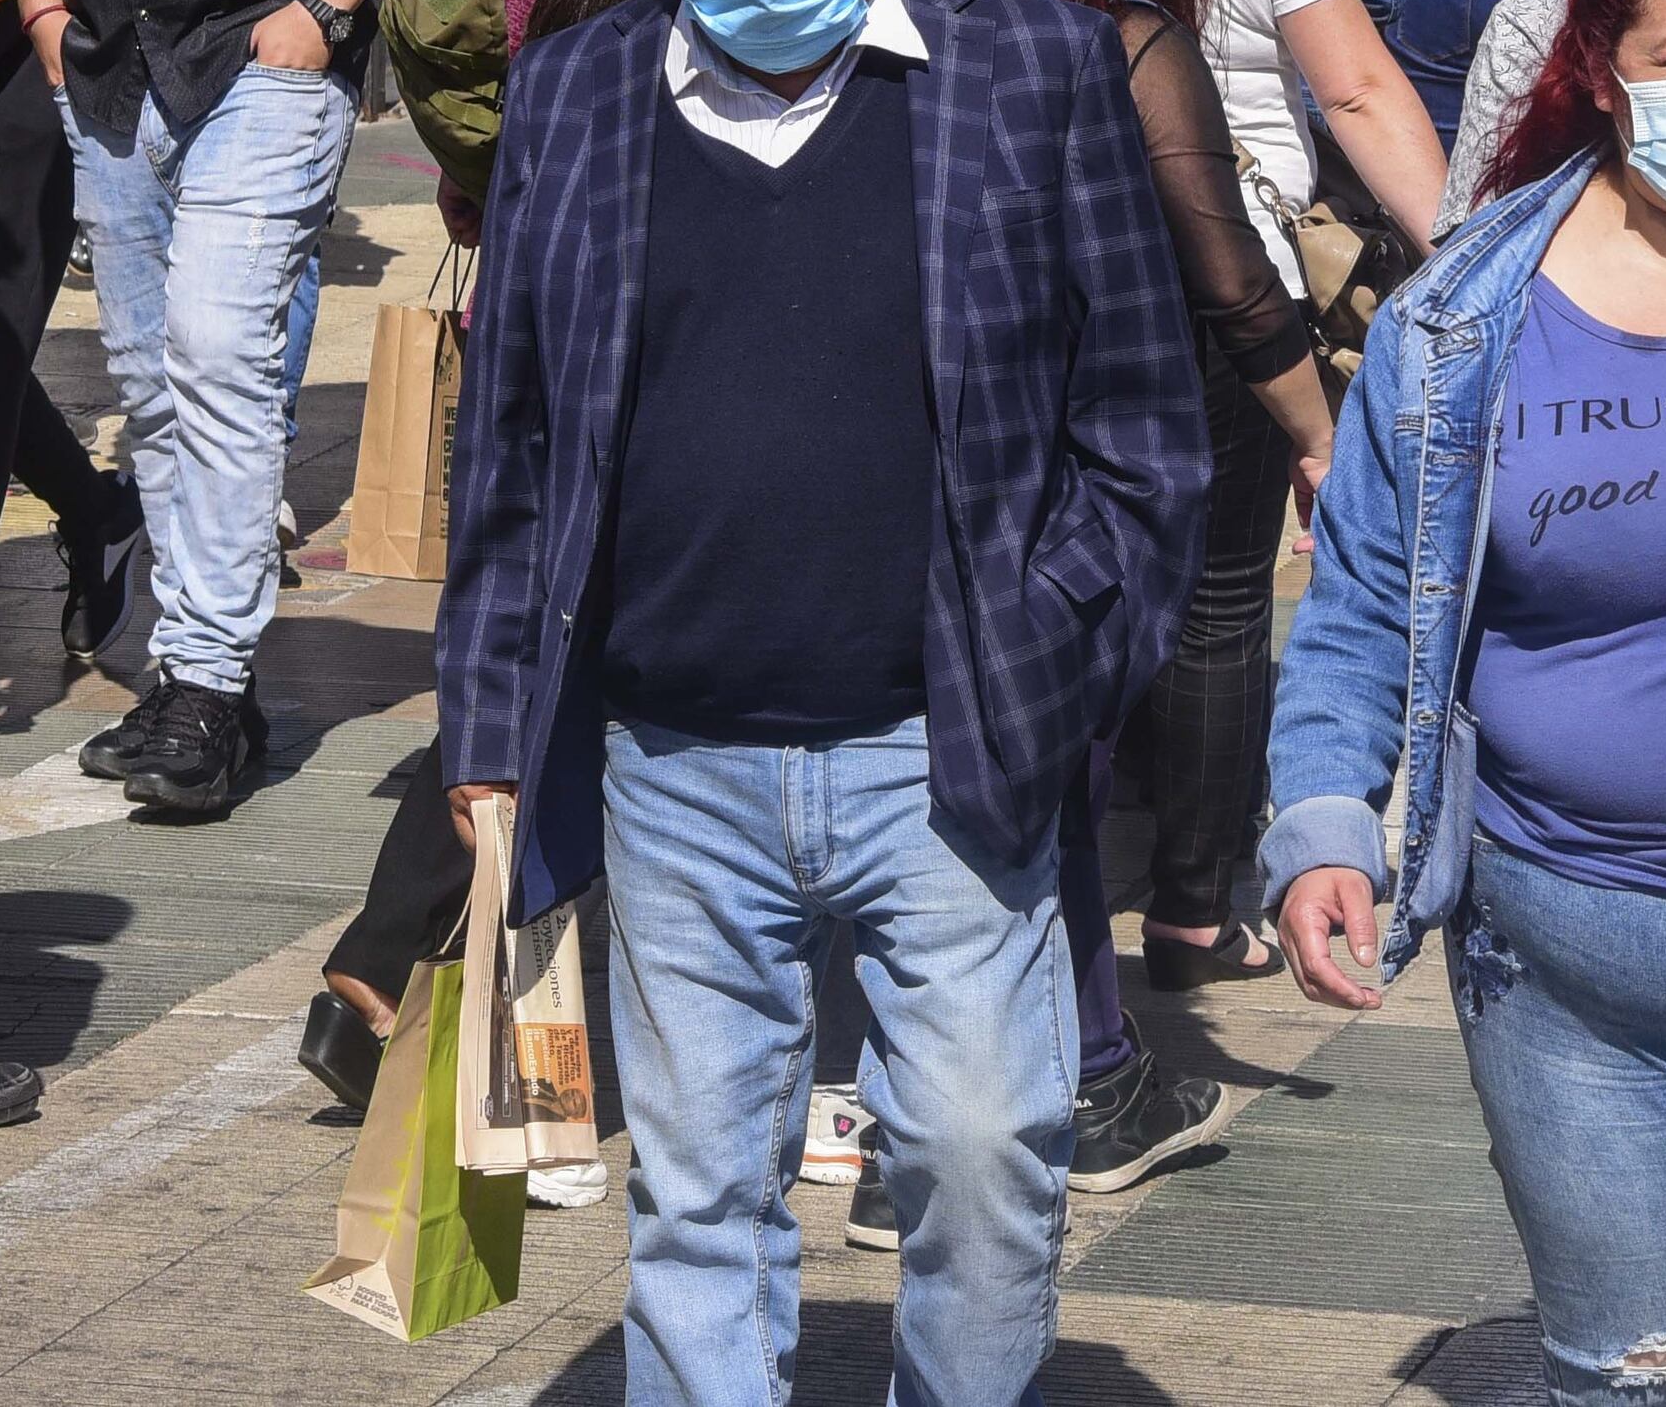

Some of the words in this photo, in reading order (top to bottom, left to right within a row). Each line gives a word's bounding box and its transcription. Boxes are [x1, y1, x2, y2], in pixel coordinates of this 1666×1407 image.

[1516, 402, 1525, 440] I
[1528, 470, 1659, 547] good
[532, 923, 545, 979] urismo
[541, 914, 563, 1009] royecciones
[525, 1028, 539, 1096] BancoEstado
